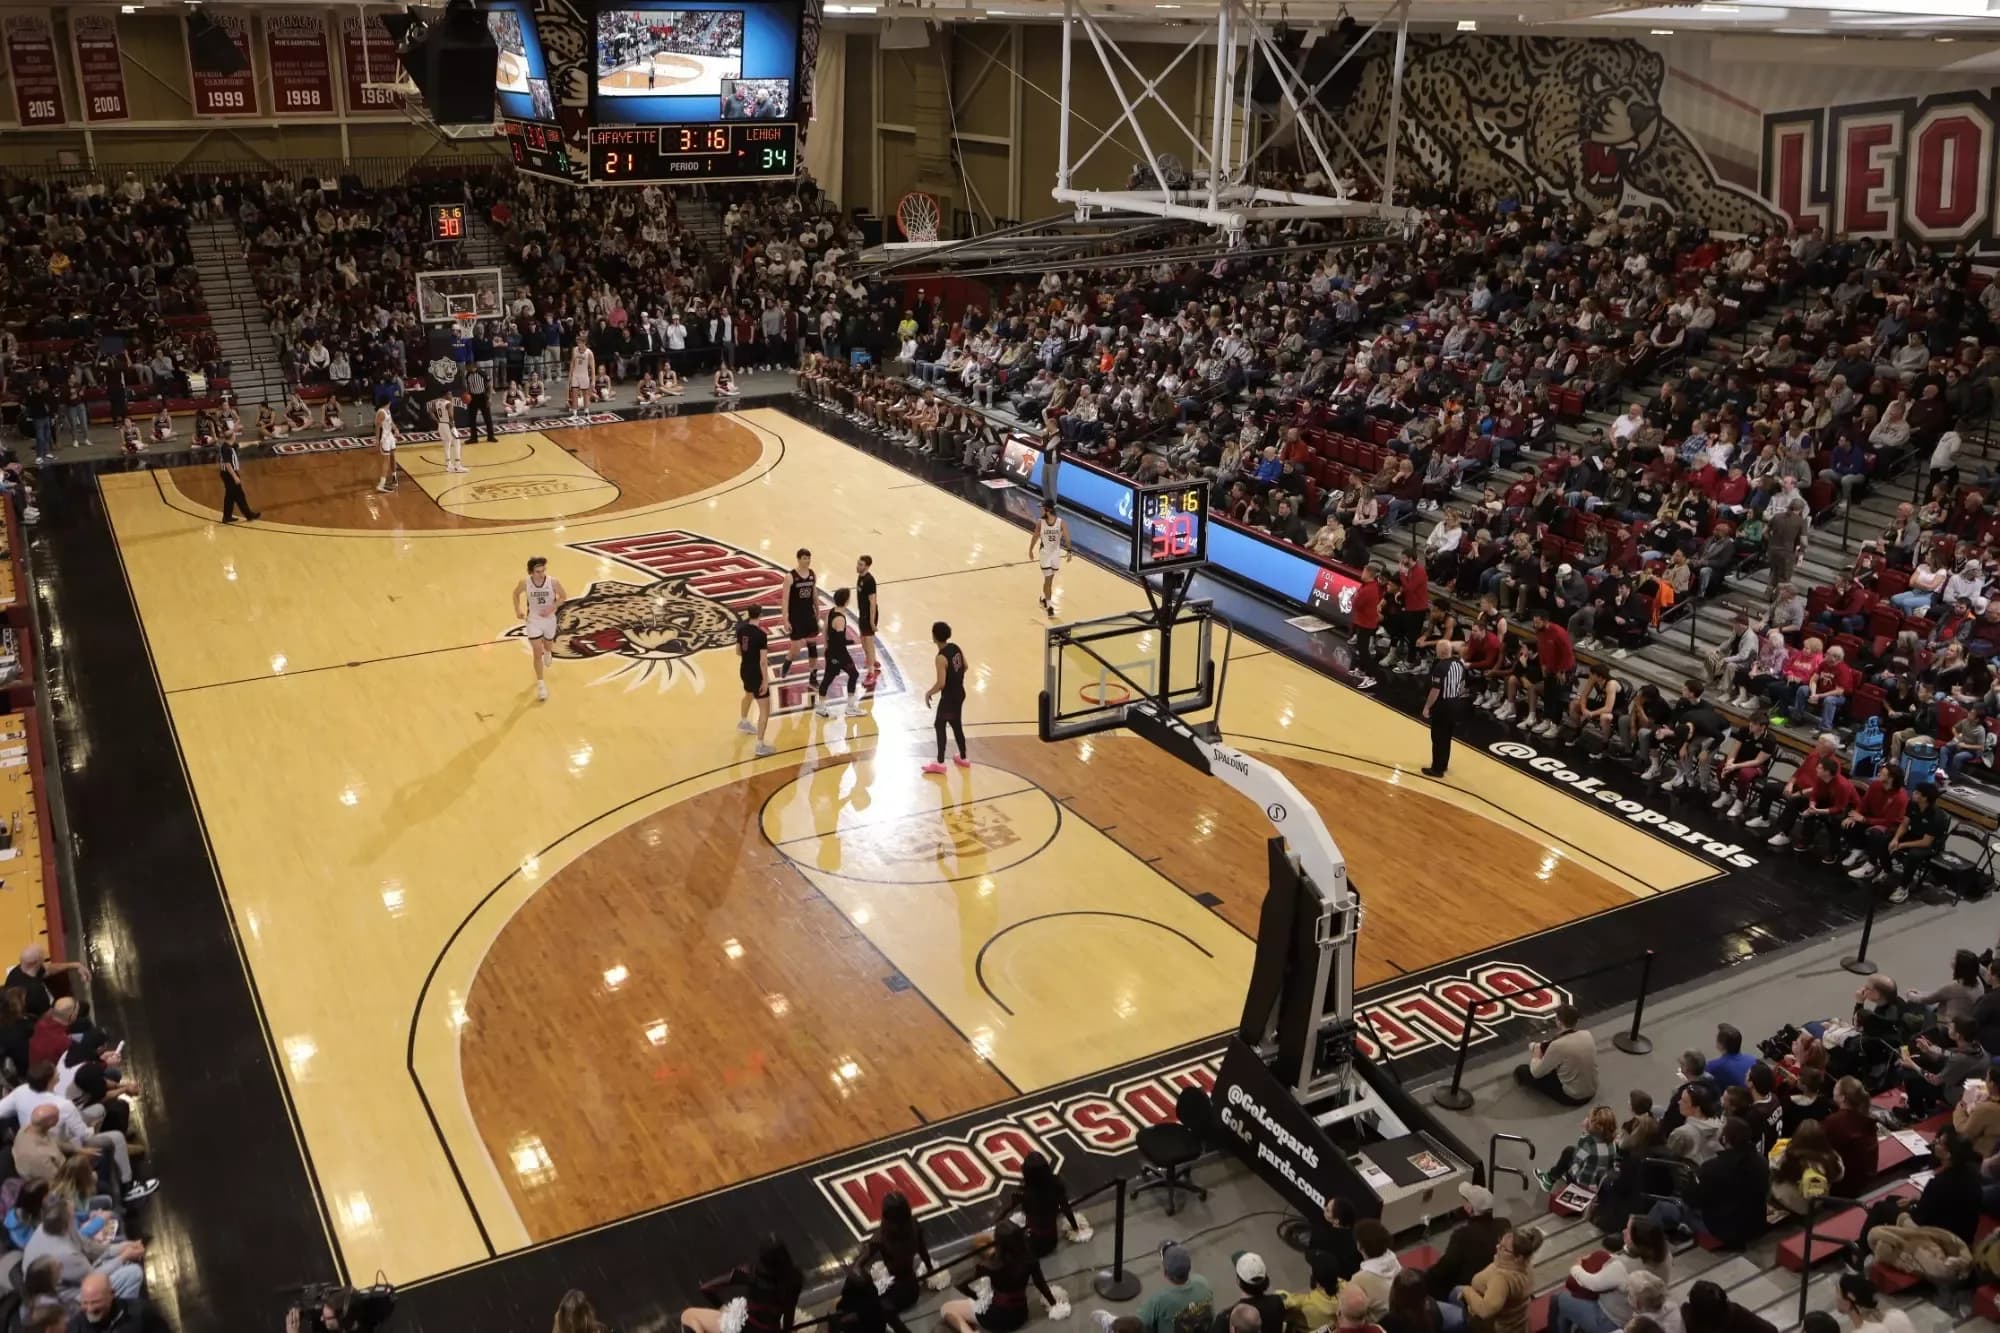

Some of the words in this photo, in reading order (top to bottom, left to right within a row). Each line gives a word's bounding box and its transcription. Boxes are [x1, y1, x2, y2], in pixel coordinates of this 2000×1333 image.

[93, 96, 121, 113] 2000
[207, 91, 245, 108] 1999
[286, 89, 321, 106] 1998
[28, 100, 56, 118] 2015
[591, 130, 657, 145] LAFAYETTE
[680, 129, 726, 150] 3:16
[746, 128, 781, 141] LEHIGH
[606, 152, 633, 174] 21
[670, 162, 699, 171] PERIOD
[762, 148, 787, 169] 34
[1768, 100, 2000, 241] LEO
[440, 207, 462, 218] 3:16
[439, 218, 460, 236] 30
[1151, 514, 1192, 559] 30
[1213, 748, 1249, 777] SPALDING
[1488, 741, 1760, 868] @GoLeopards
[1228, 1084, 1320, 1169] @GoLeopards
